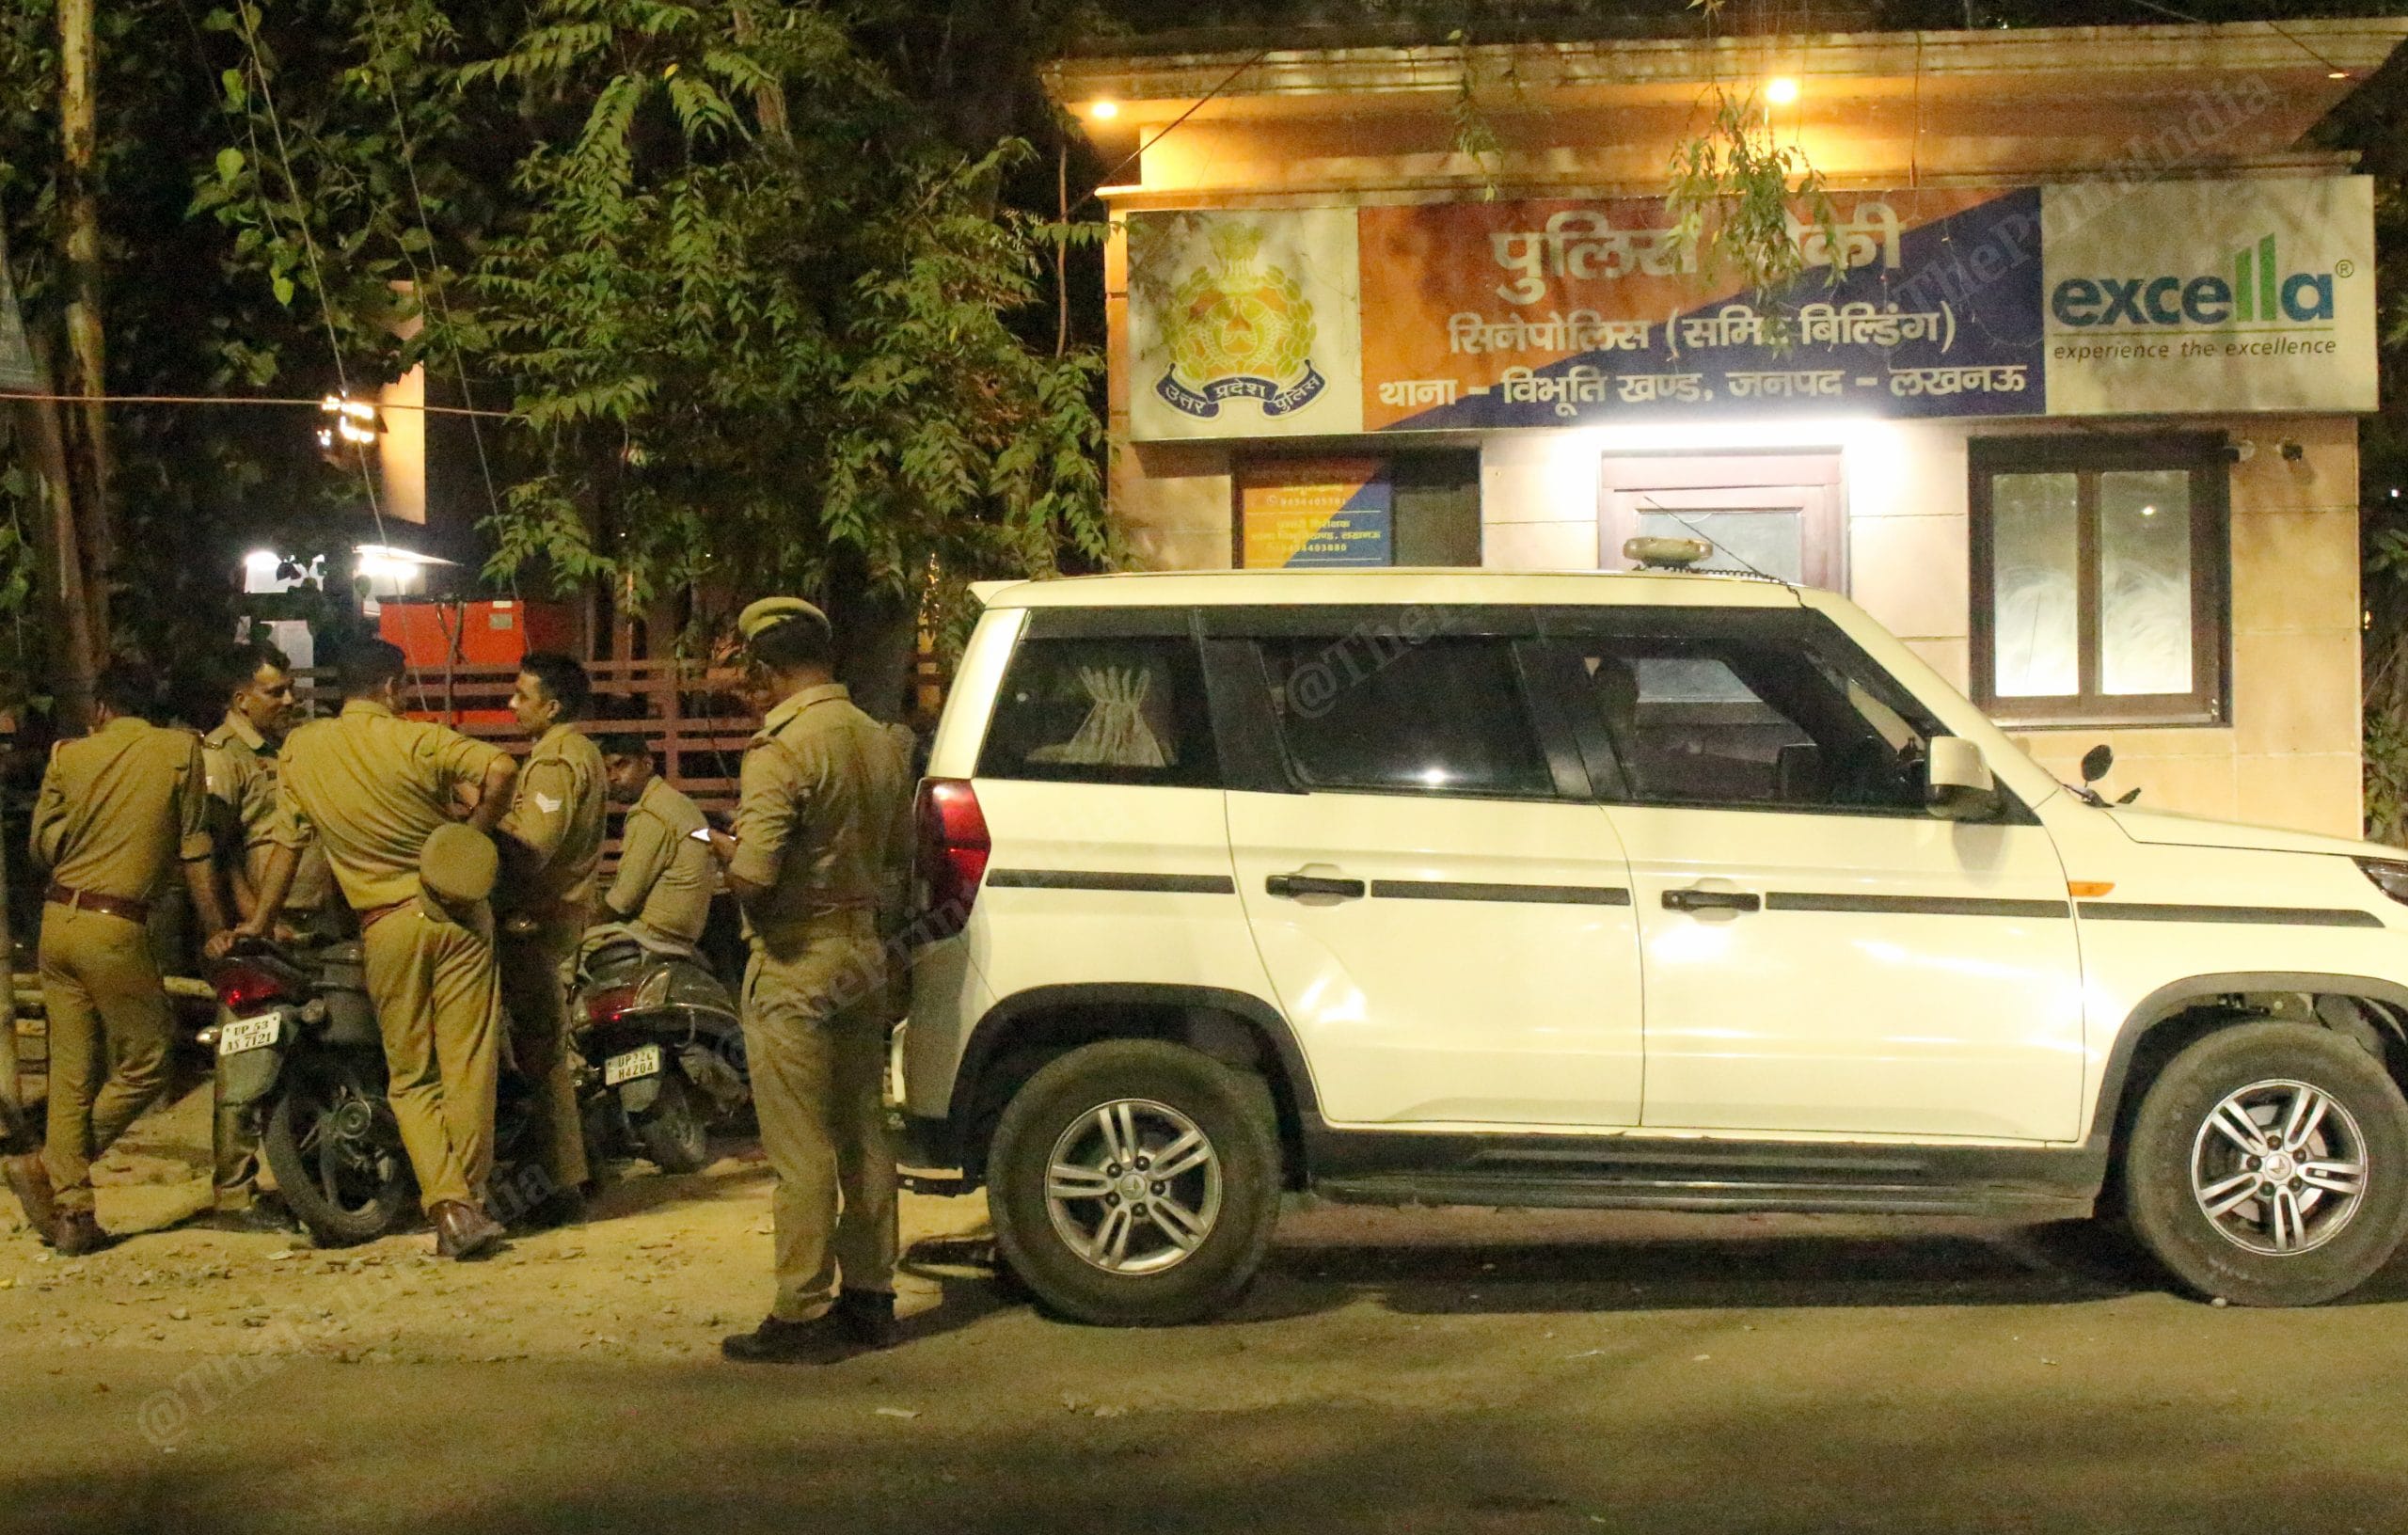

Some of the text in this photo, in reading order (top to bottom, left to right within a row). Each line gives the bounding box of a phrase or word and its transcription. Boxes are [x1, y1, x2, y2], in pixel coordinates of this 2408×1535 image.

[1488, 210, 1698, 306] पुलिस
[1449, 309, 1650, 354] सिनेपोलिस
[1798, 300, 1956, 354] बिल्डिंग)
[2053, 337, 2337, 362] experience the excellence
[1165, 375, 1321, 415] उत्तर प्रदेश पुलिस
[1378, 379, 1458, 406] थाना
[1501, 365, 1609, 417] विभूति
[1725, 370, 1846, 397] जनपद
[1887, 365, 2027, 397] लखनऊ
